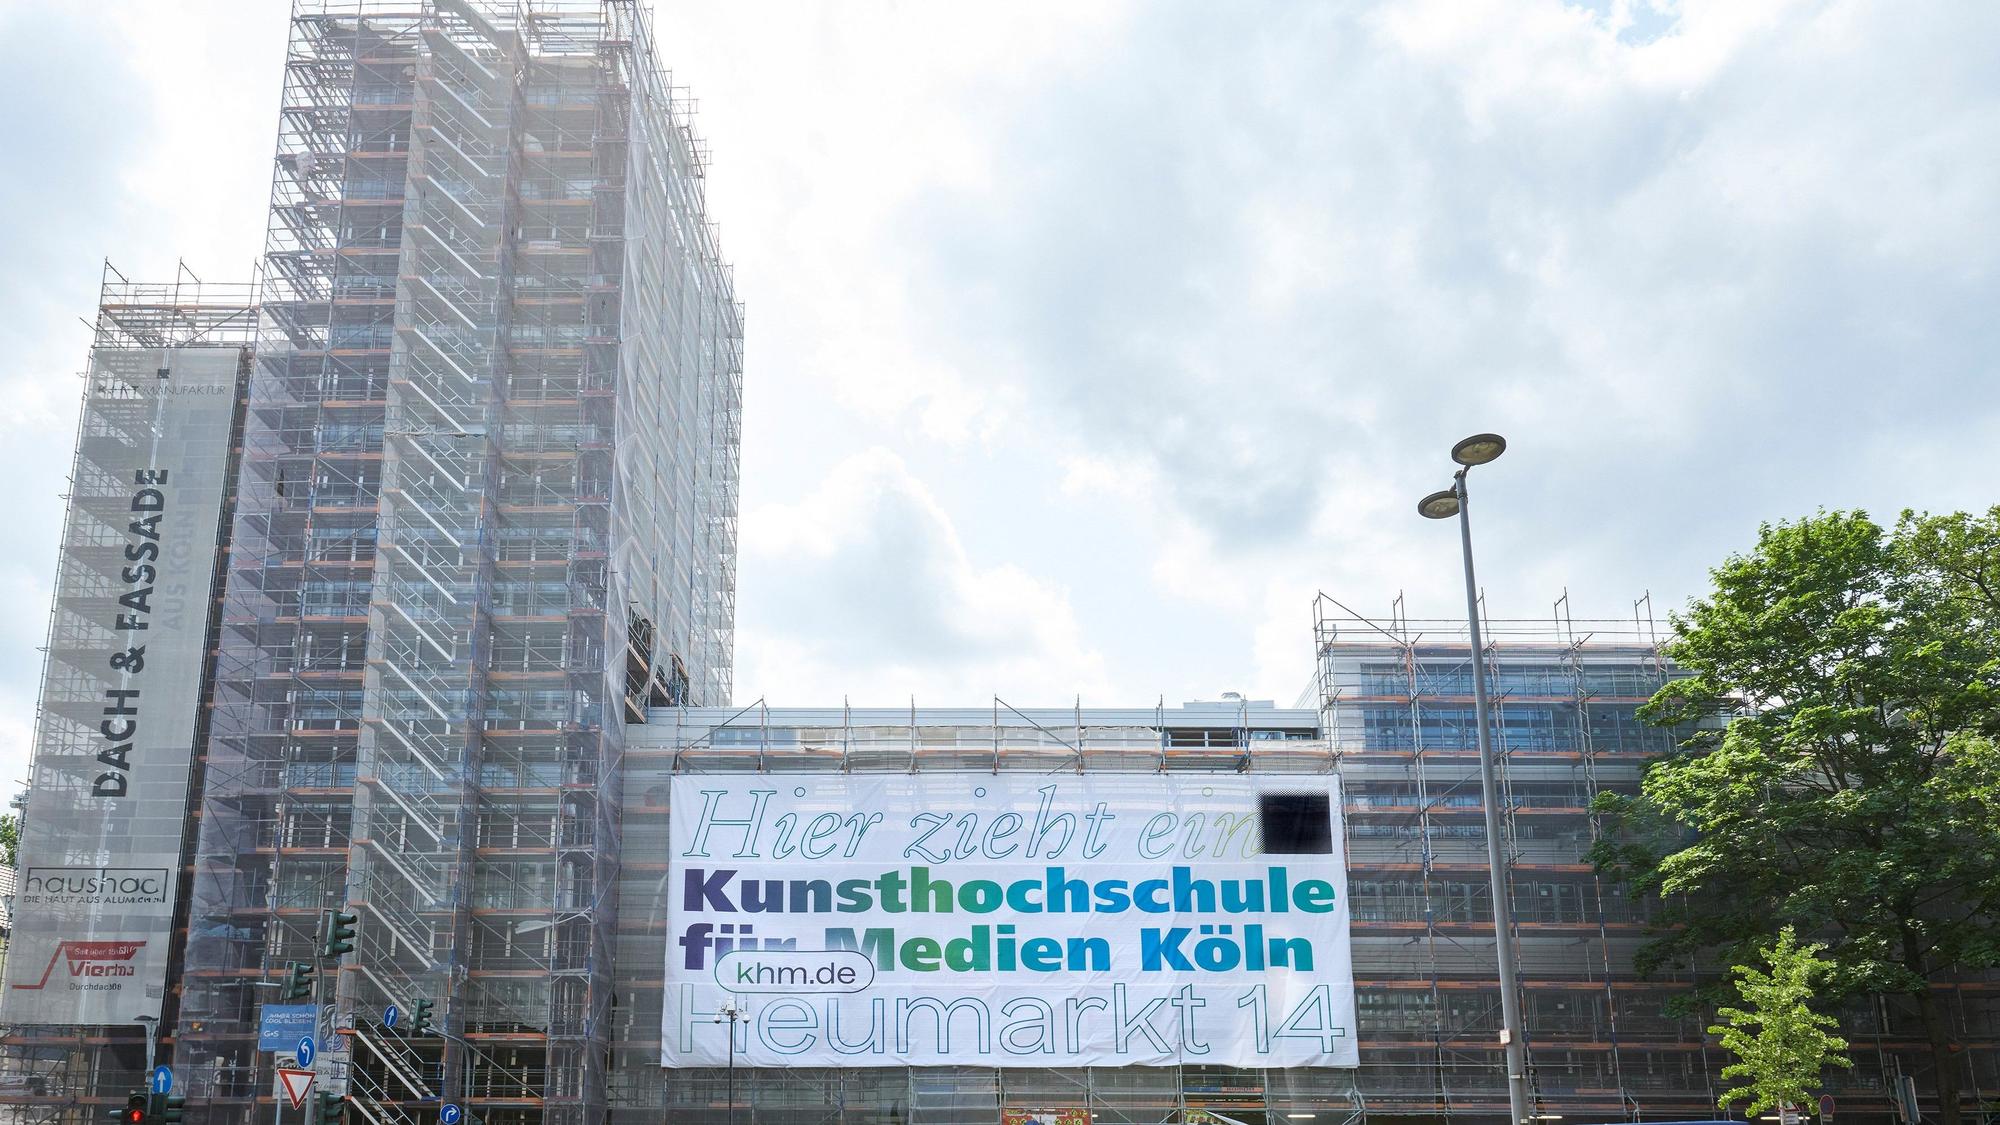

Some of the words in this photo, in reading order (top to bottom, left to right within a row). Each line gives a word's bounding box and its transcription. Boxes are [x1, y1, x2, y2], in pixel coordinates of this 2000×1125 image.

[115, 469, 168, 630] FASSADE
[110, 645, 146, 674] &
[92, 690, 140, 797] DACH
[682, 786, 883, 860] Hier
[903, 784, 1115, 864] zieht
[1138, 786, 1264, 860] ein
[24, 895, 40, 903] DIE
[44, 895, 75, 904] HAUT
[78, 896, 100, 904] AUS
[683, 866, 1335, 913] Kunsthochschule
[824, 924, 1110, 972] Medien
[1140, 924, 1314, 972] Köln
[737, 962, 856, 985] khm.de
[679, 983, 1210, 1055] Heumarkt
[1238, 984, 1345, 1054] 14
